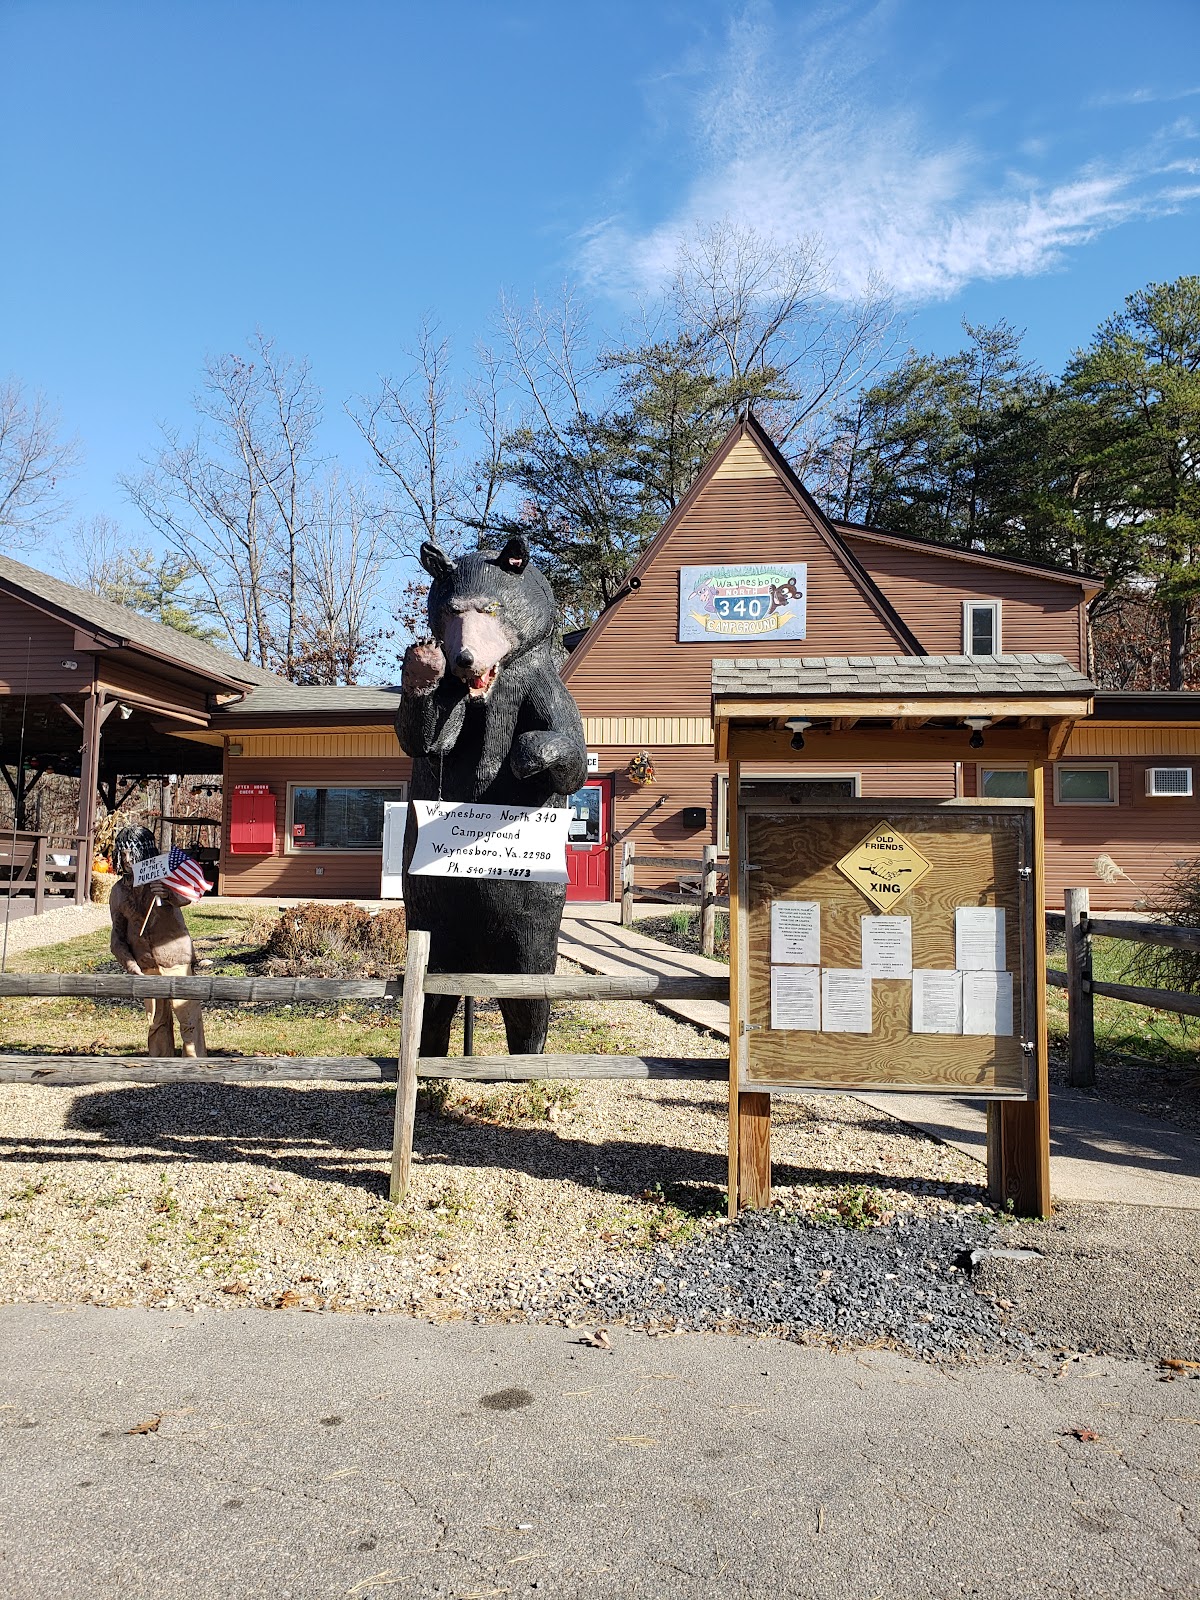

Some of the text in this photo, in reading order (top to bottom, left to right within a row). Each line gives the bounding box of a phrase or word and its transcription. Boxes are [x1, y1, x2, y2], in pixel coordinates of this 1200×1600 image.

[716, 576, 780, 589] Waynesboro
[725, 588, 758, 596] NORTH
[719, 599, 761, 617] 340
[707, 617, 777, 633] CAMPGROUND
[425, 805, 557, 823] Waynesboro North 340
[451, 825, 521, 842] Campground
[504, 846, 521, 859] Va.
[523, 851, 551, 860] 22980
[865, 842, 904, 851] FRIENDS
[141, 857, 156, 868] HOME
[446, 861, 463, 874] Ph.
[138, 870, 160, 883] PURPLE
[139, 867, 146, 875] OF
[869, 882, 901, 893] XING
